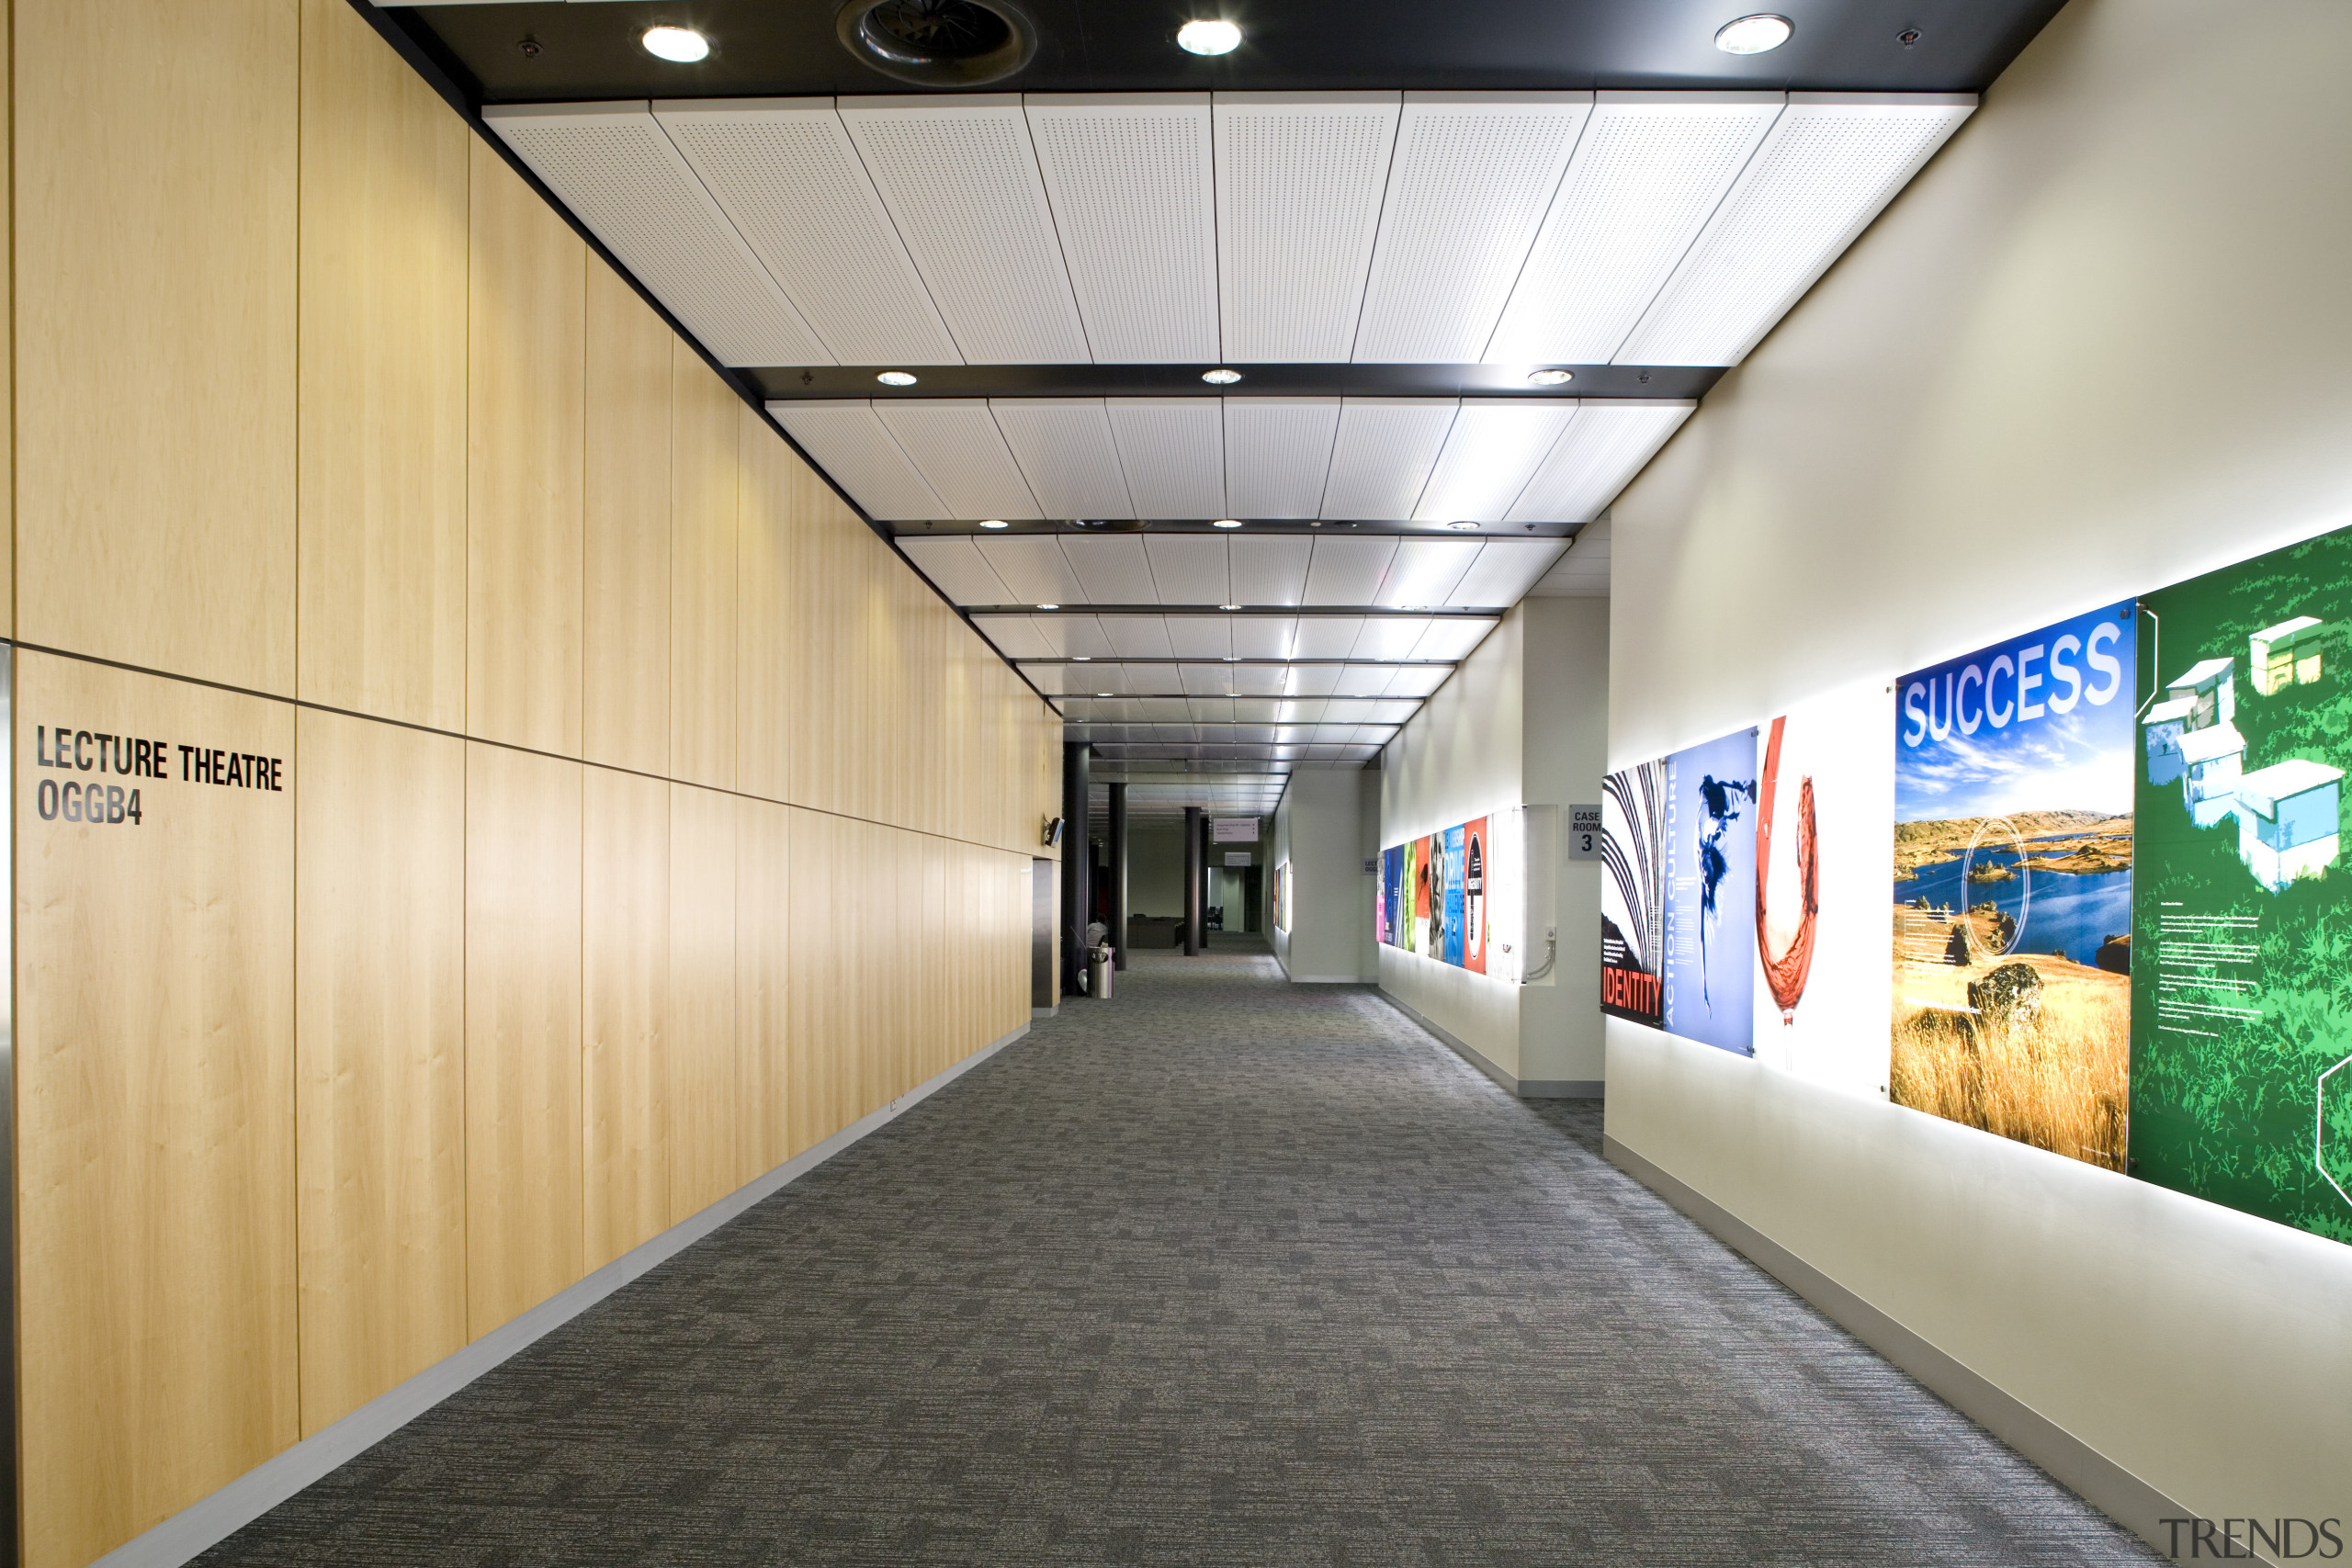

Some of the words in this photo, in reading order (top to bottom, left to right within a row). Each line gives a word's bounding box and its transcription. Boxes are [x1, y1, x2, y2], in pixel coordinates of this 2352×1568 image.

[1903, 621, 2121, 748] SUCCESS
[37, 725, 168, 779] LECTURE
[177, 744, 283, 792] THEATRE
[37, 778, 142, 826] OGGB4
[1572, 822, 1601, 832] ROOM
[1574, 812, 1600, 821] CASE
[1581, 834, 1592, 852] 3
[1667, 761, 1677, 901] CULTURE
[1602, 965, 1662, 1017] IDENTITY
[1666, 912, 1675, 1028] ACTION
